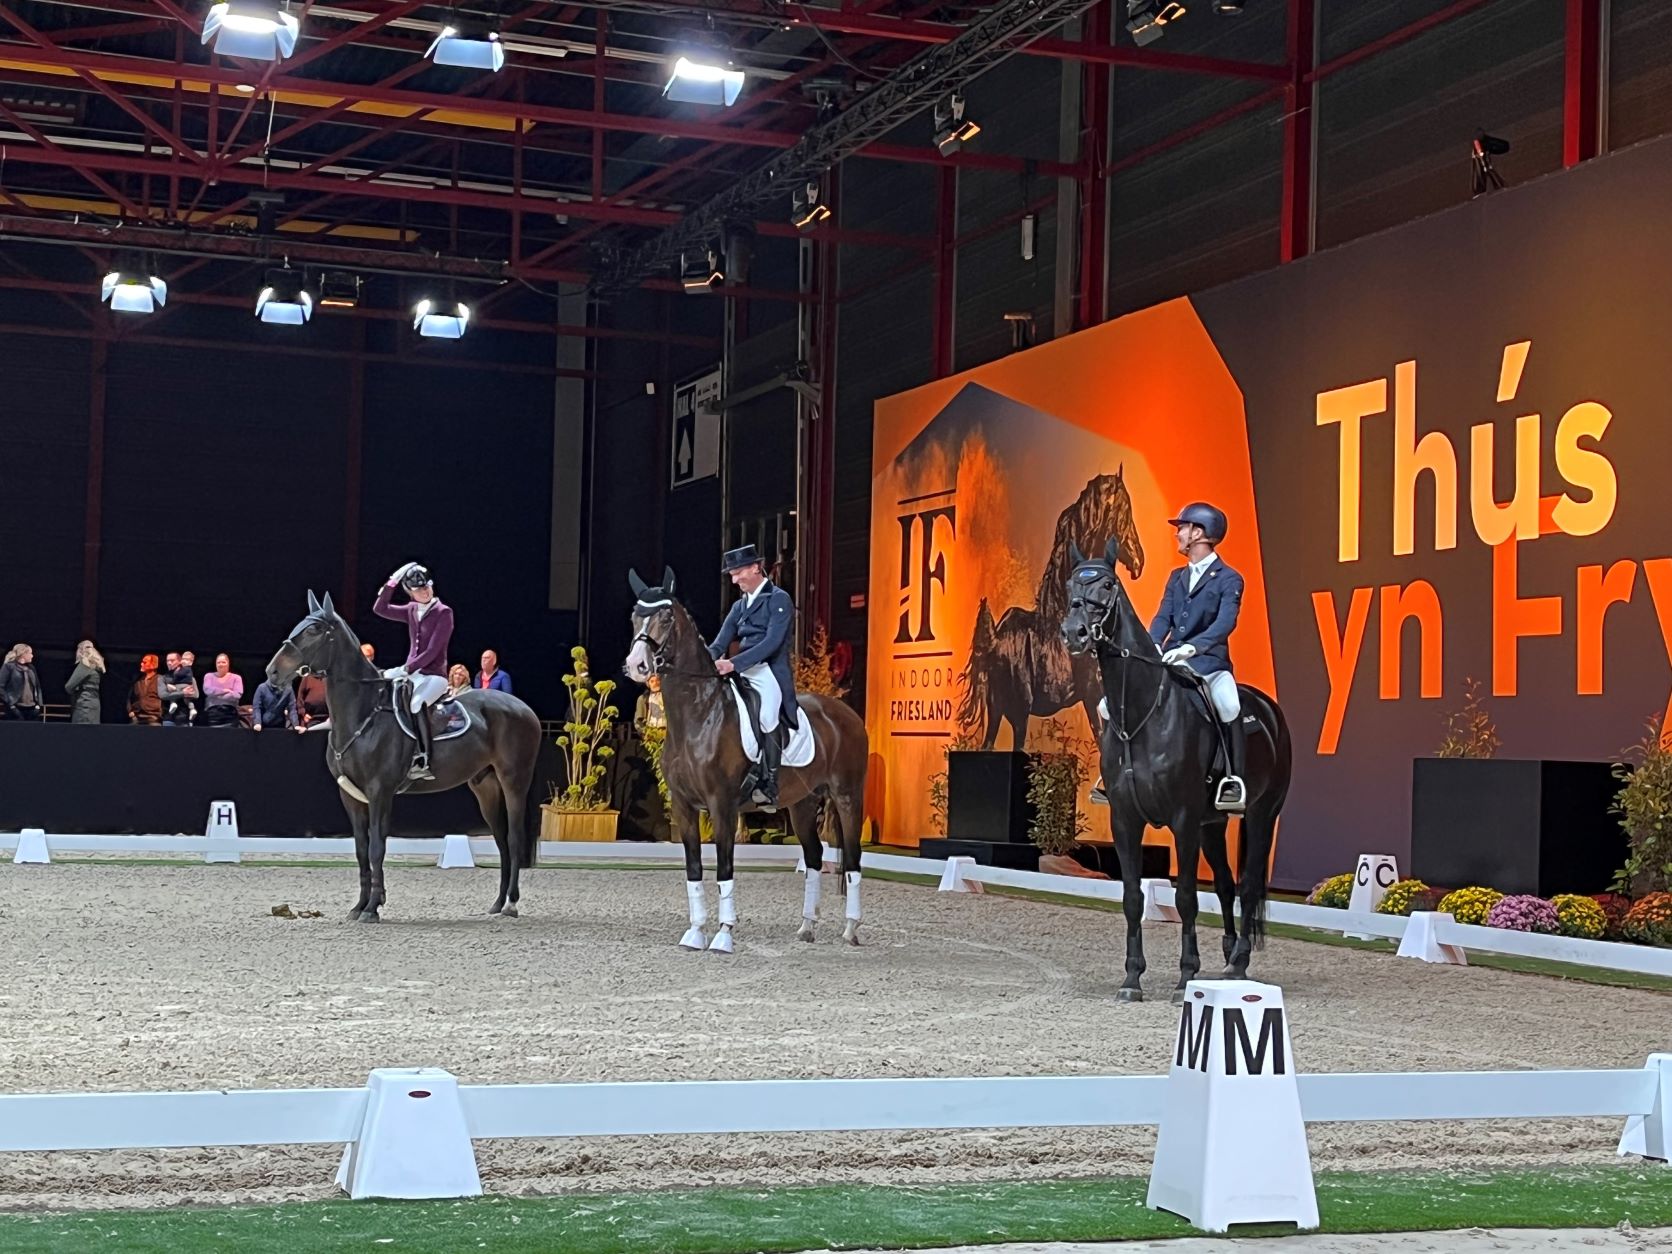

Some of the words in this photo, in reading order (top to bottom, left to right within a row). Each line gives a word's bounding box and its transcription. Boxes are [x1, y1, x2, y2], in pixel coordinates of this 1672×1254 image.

[1316, 340, 1618, 562] Thús
[893, 505, 957, 644] IF
[891, 668, 953, 689] INDOOR
[1311, 580, 1443, 755] yn
[890, 699, 952, 721] FRIESLAND
[217, 807, 232, 826] H
[1357, 861, 1370, 887] C
[1375, 862, 1396, 889] C
[1176, 1000, 1214, 1073] M
[1222, 1007, 1286, 1076] M
